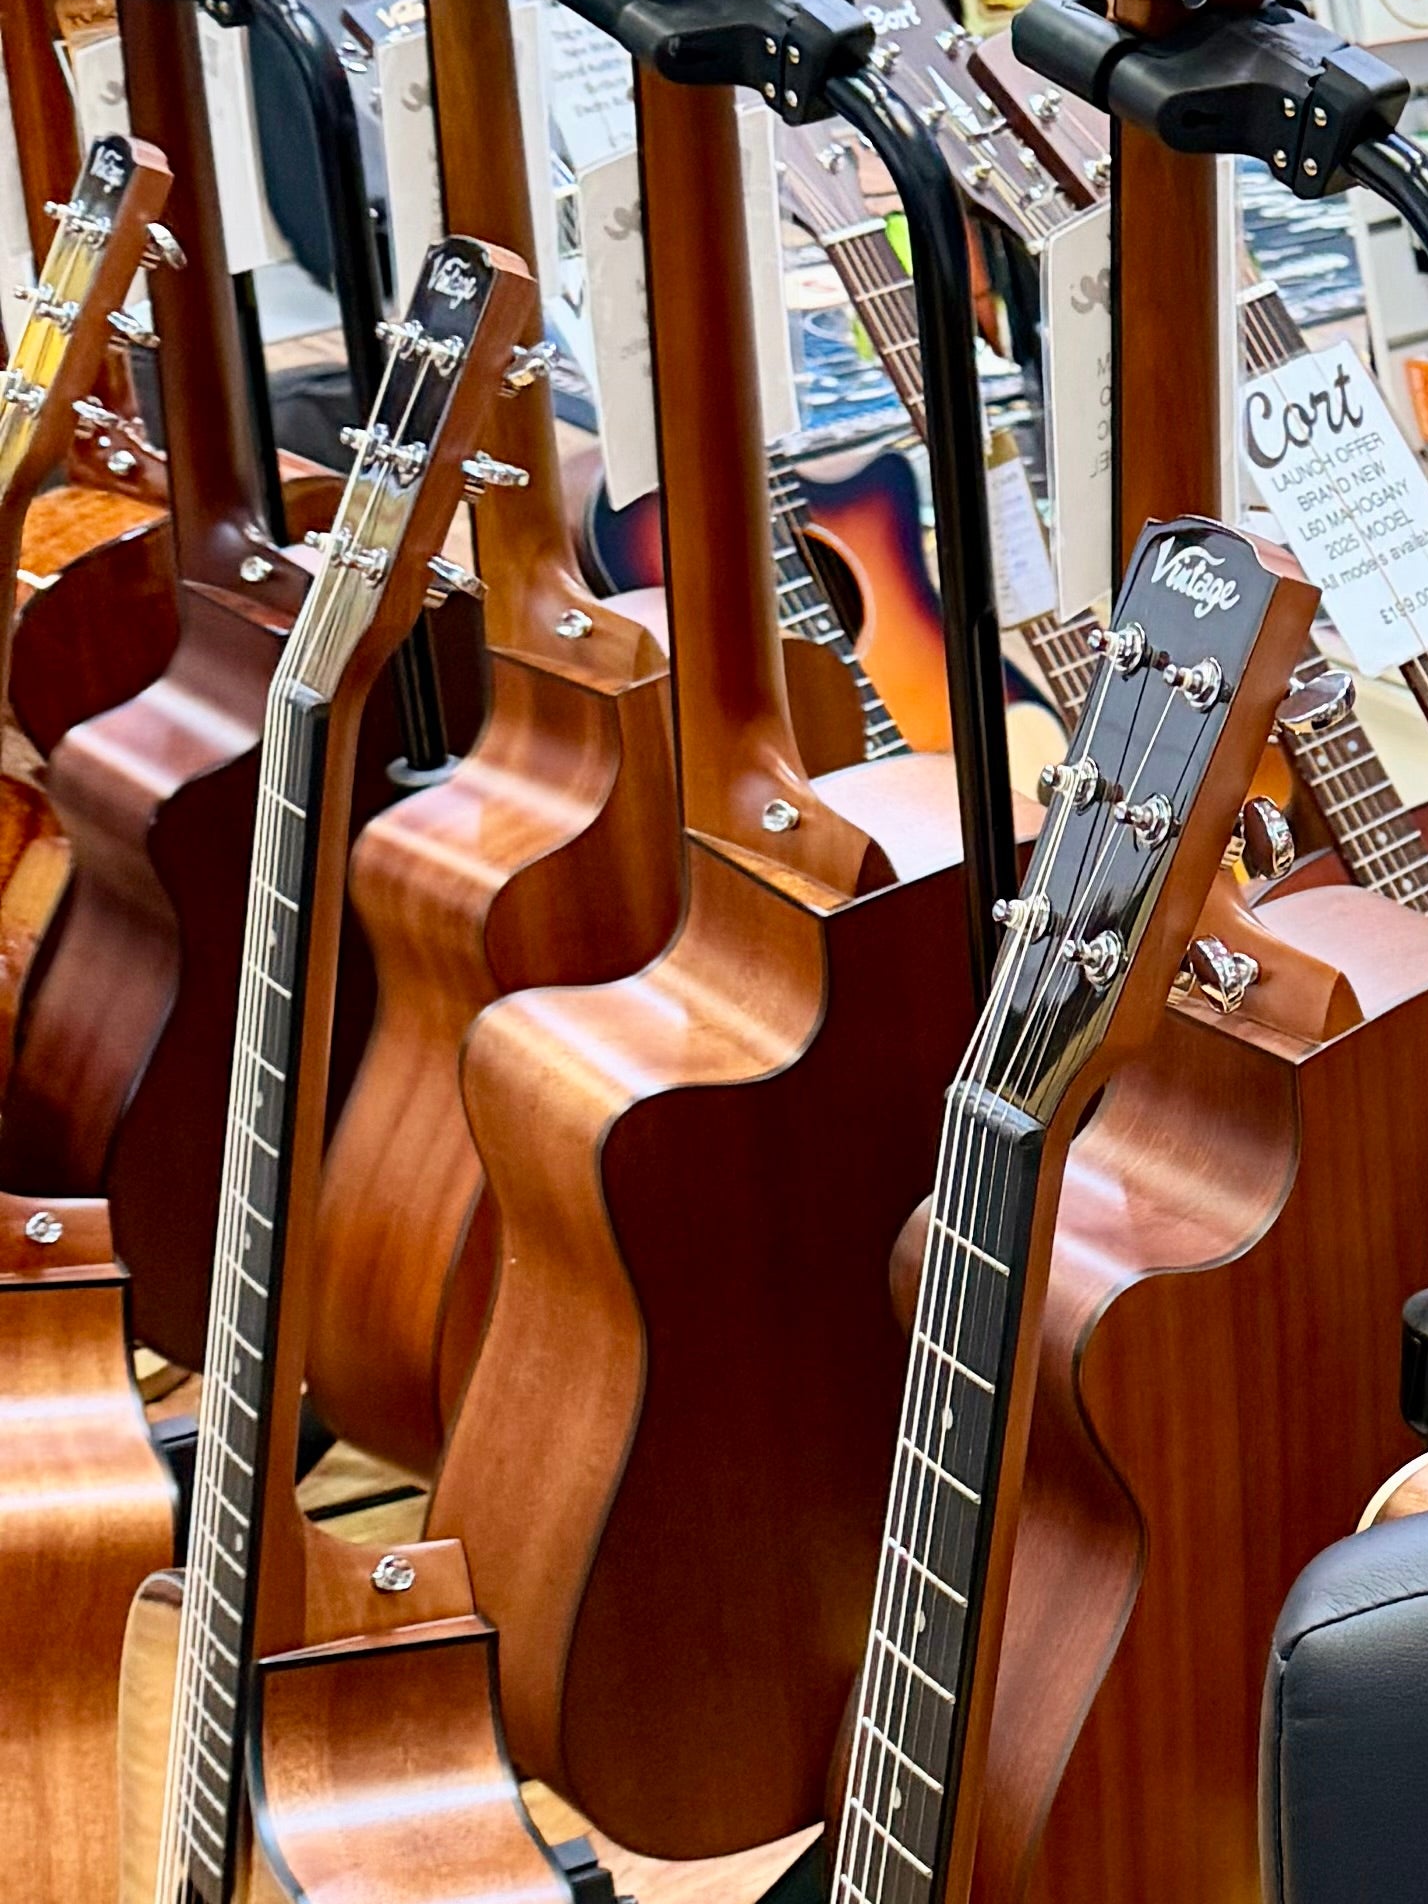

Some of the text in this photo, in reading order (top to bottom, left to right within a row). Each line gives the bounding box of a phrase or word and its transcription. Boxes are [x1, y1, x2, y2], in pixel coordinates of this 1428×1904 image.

[862, 0, 922, 36] Cort
[1245, 363, 1363, 469] Cort
[1271, 432, 1386, 493] LAUNCH OFFER
[1296, 460, 1388, 513] BRAND NEW
[1298, 479, 1410, 543] L60 MAHOGANY
[1324, 510, 1415, 561] 2025 MODEL
[1152, 536, 1241, 620] Vintage
[1320, 573, 1340, 594] All
[1339, 552, 1390, 589] models
